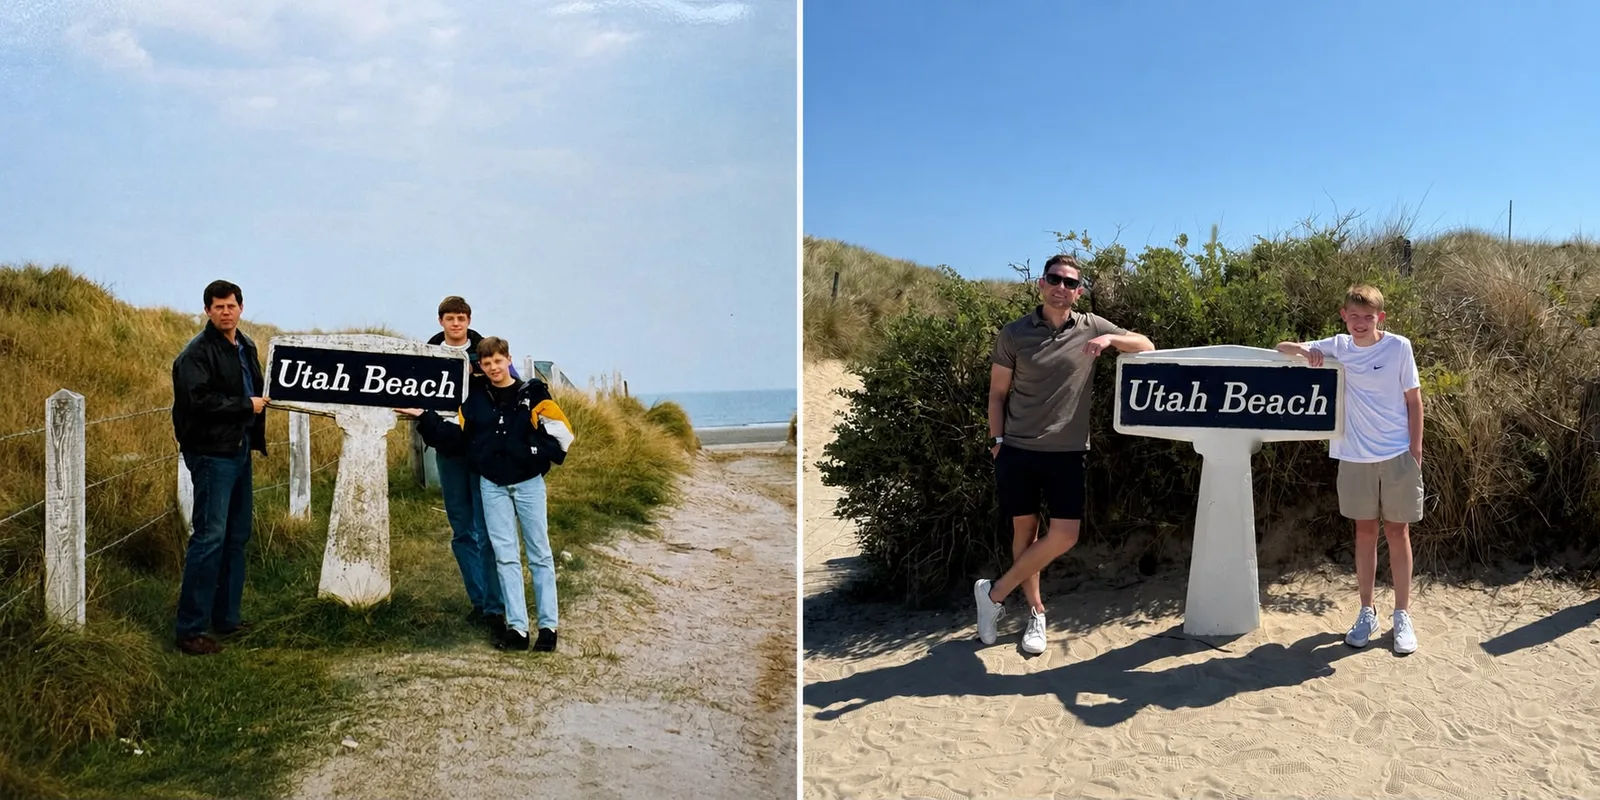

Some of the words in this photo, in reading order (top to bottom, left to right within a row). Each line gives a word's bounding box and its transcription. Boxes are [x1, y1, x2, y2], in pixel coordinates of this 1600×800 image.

[278, 358, 351, 392] Utah
[359, 364, 456, 399] Beach
[1128, 379, 1208, 413] Utah
[1218, 381, 1328, 416] Beach
